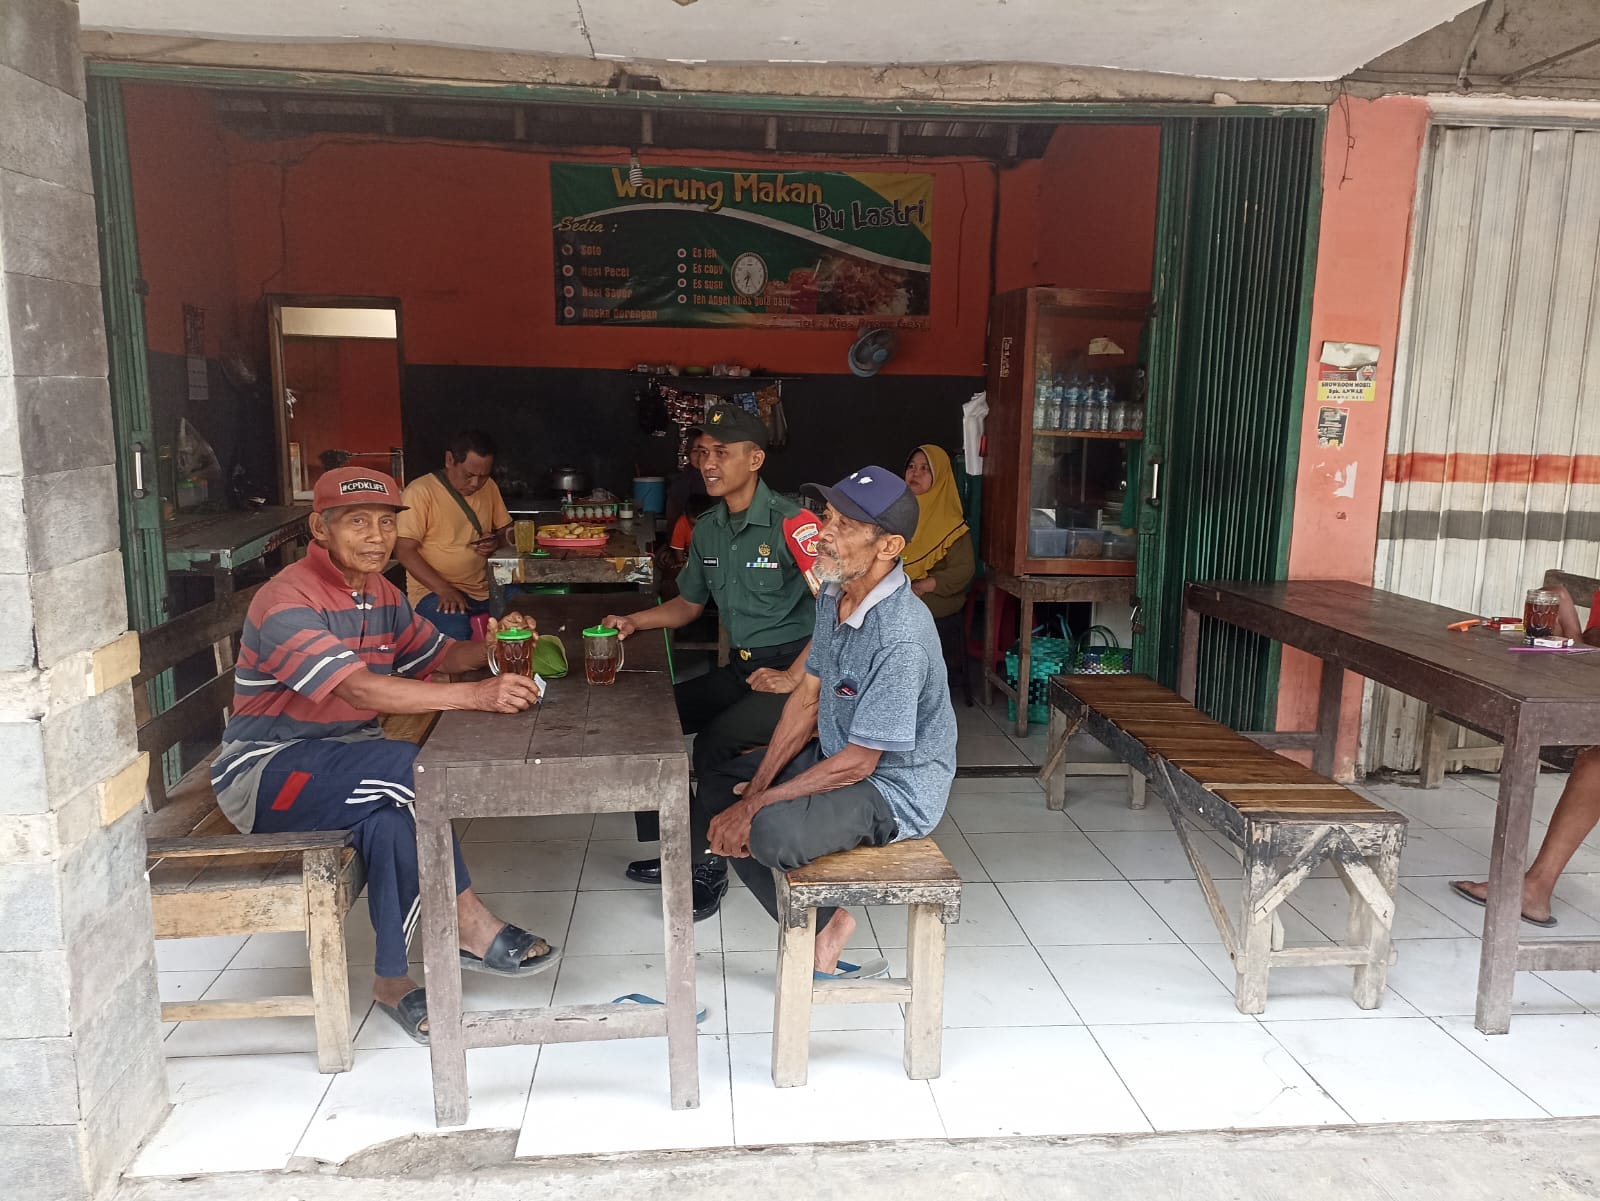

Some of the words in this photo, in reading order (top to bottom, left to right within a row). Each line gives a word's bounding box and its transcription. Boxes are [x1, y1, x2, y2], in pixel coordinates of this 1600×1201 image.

[611, 167, 724, 212] Warung
[733, 173, 823, 204] Makan
[812, 203, 845, 233] Bu
[851, 199, 927, 231] Lastri
[558, 216, 605, 233] Sedia
[580, 245, 602, 256] Soto
[692, 247, 702, 258] Es
[692, 263, 702, 274] Es
[692, 279, 702, 289] Es
